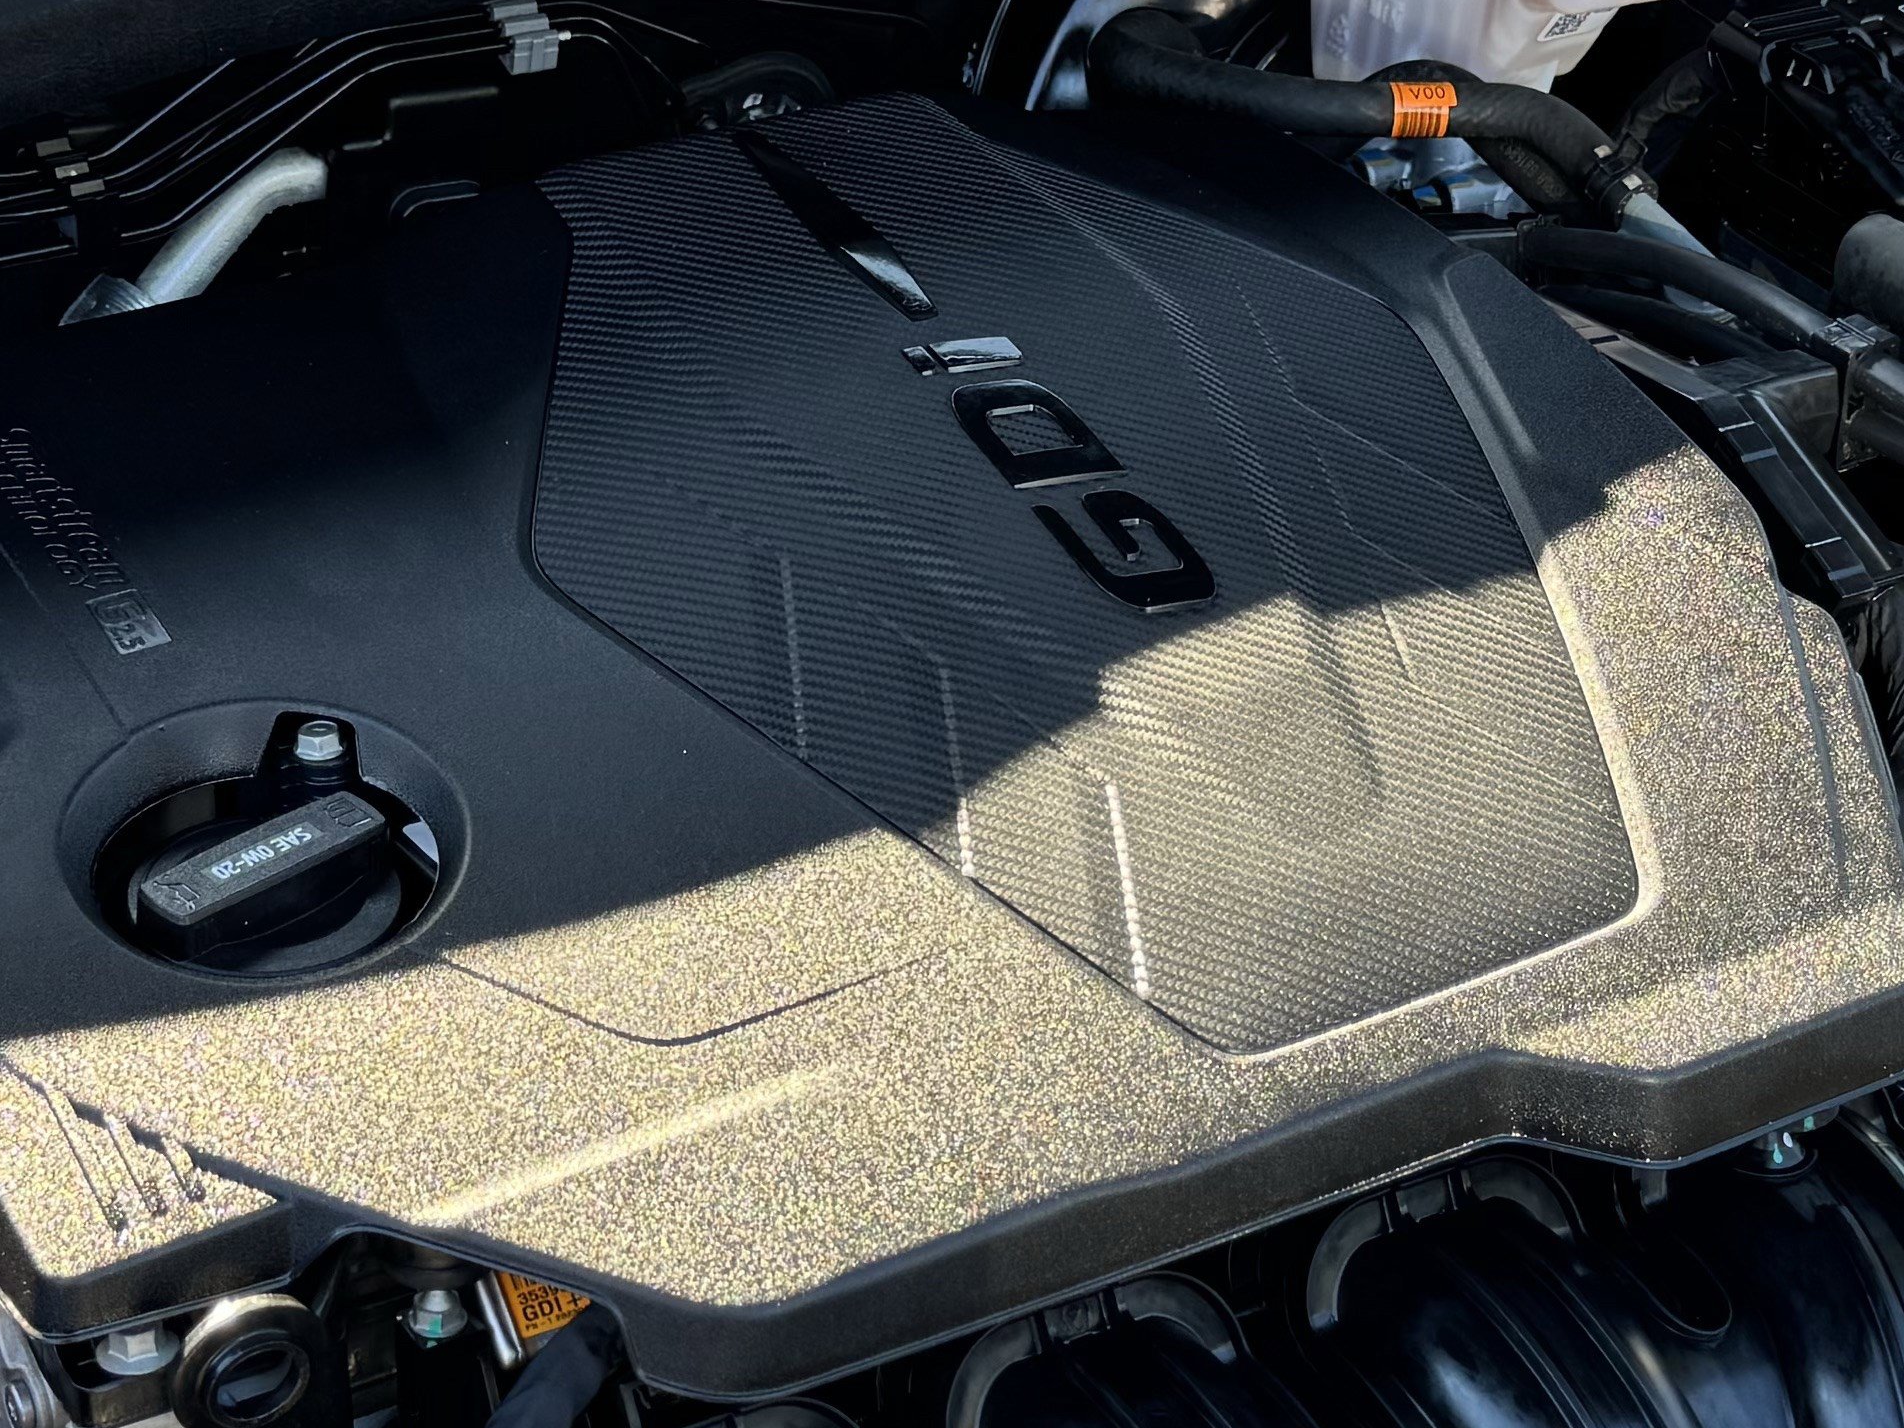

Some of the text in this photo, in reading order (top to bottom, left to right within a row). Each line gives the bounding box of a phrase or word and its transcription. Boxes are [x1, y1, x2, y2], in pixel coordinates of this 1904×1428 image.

[210, 827, 314, 880] SAE 0W-20
[521, 1300, 565, 1324] GDI
